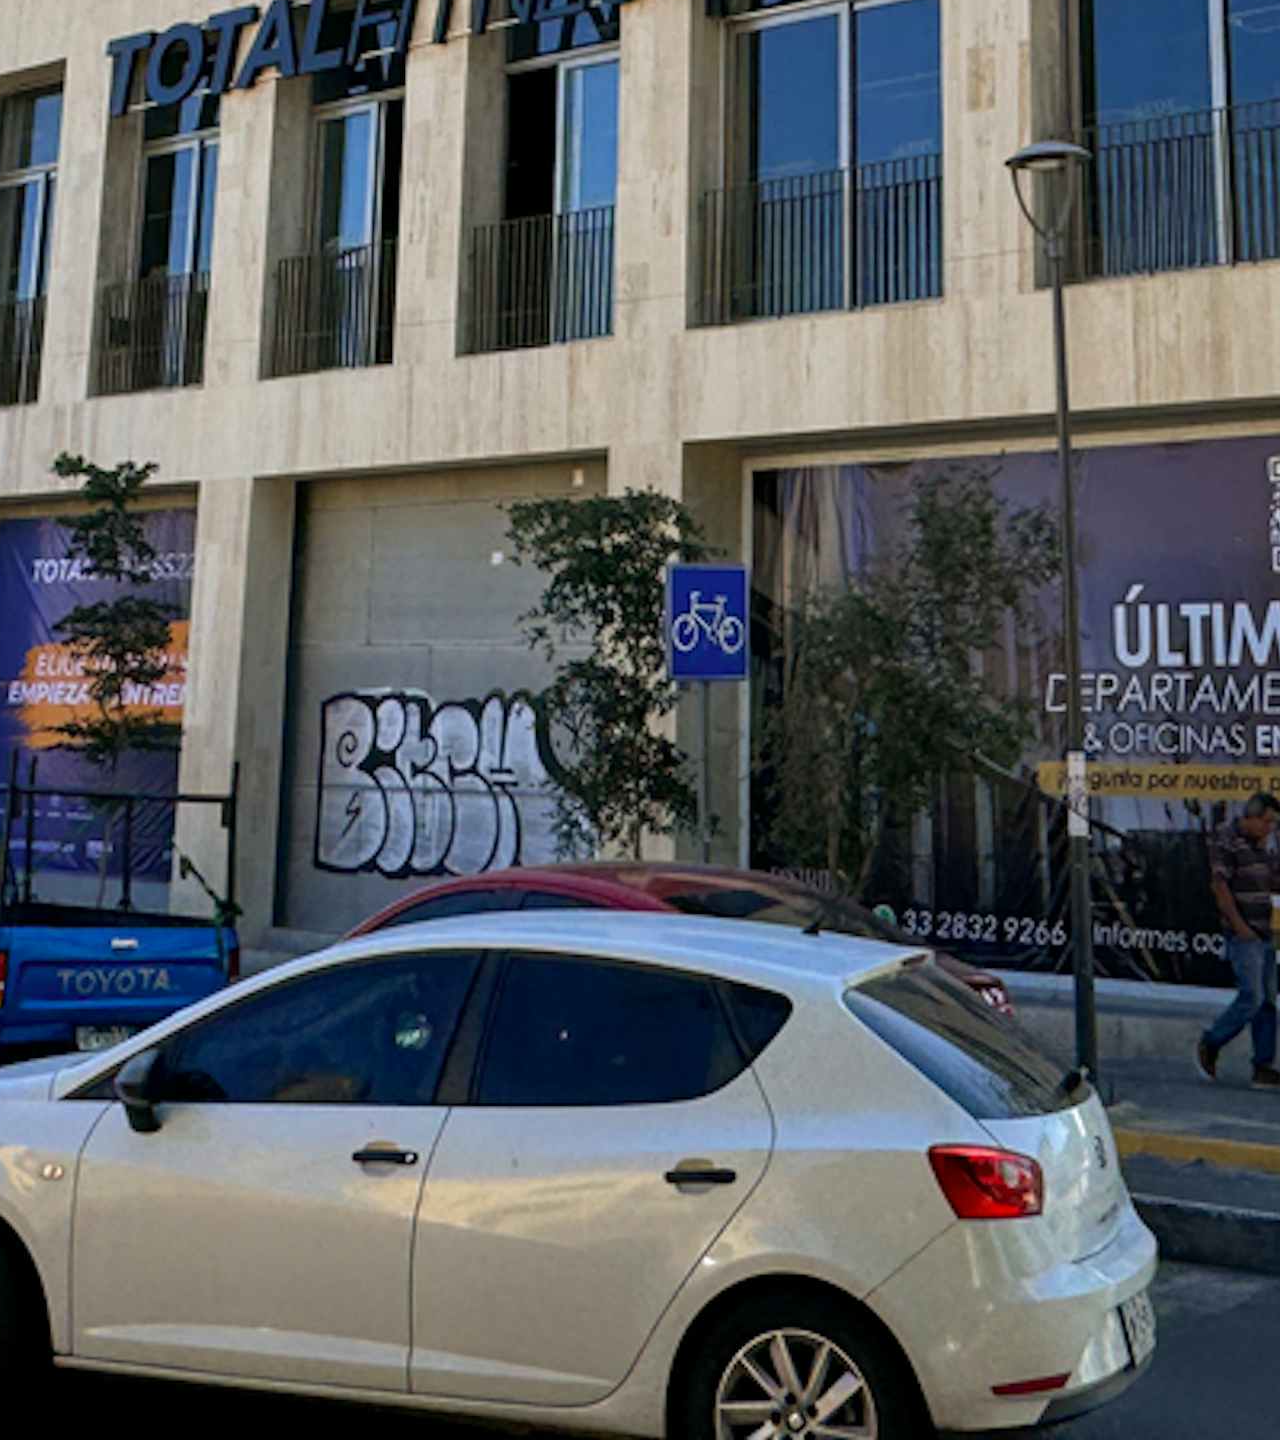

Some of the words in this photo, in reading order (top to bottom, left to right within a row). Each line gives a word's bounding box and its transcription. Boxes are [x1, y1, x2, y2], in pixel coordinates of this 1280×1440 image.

[1083, 723, 1104, 753] &
[1109, 722, 1247, 756] OFICINAS
[1147, 773, 1181, 795] por
[902, 907, 933, 936] 33
[936, 910, 998, 943] 2832
[1003, 916, 1068, 947] 9266
[1093, 919, 1189, 953] Informes
[56, 968, 172, 995] TOYOTA
